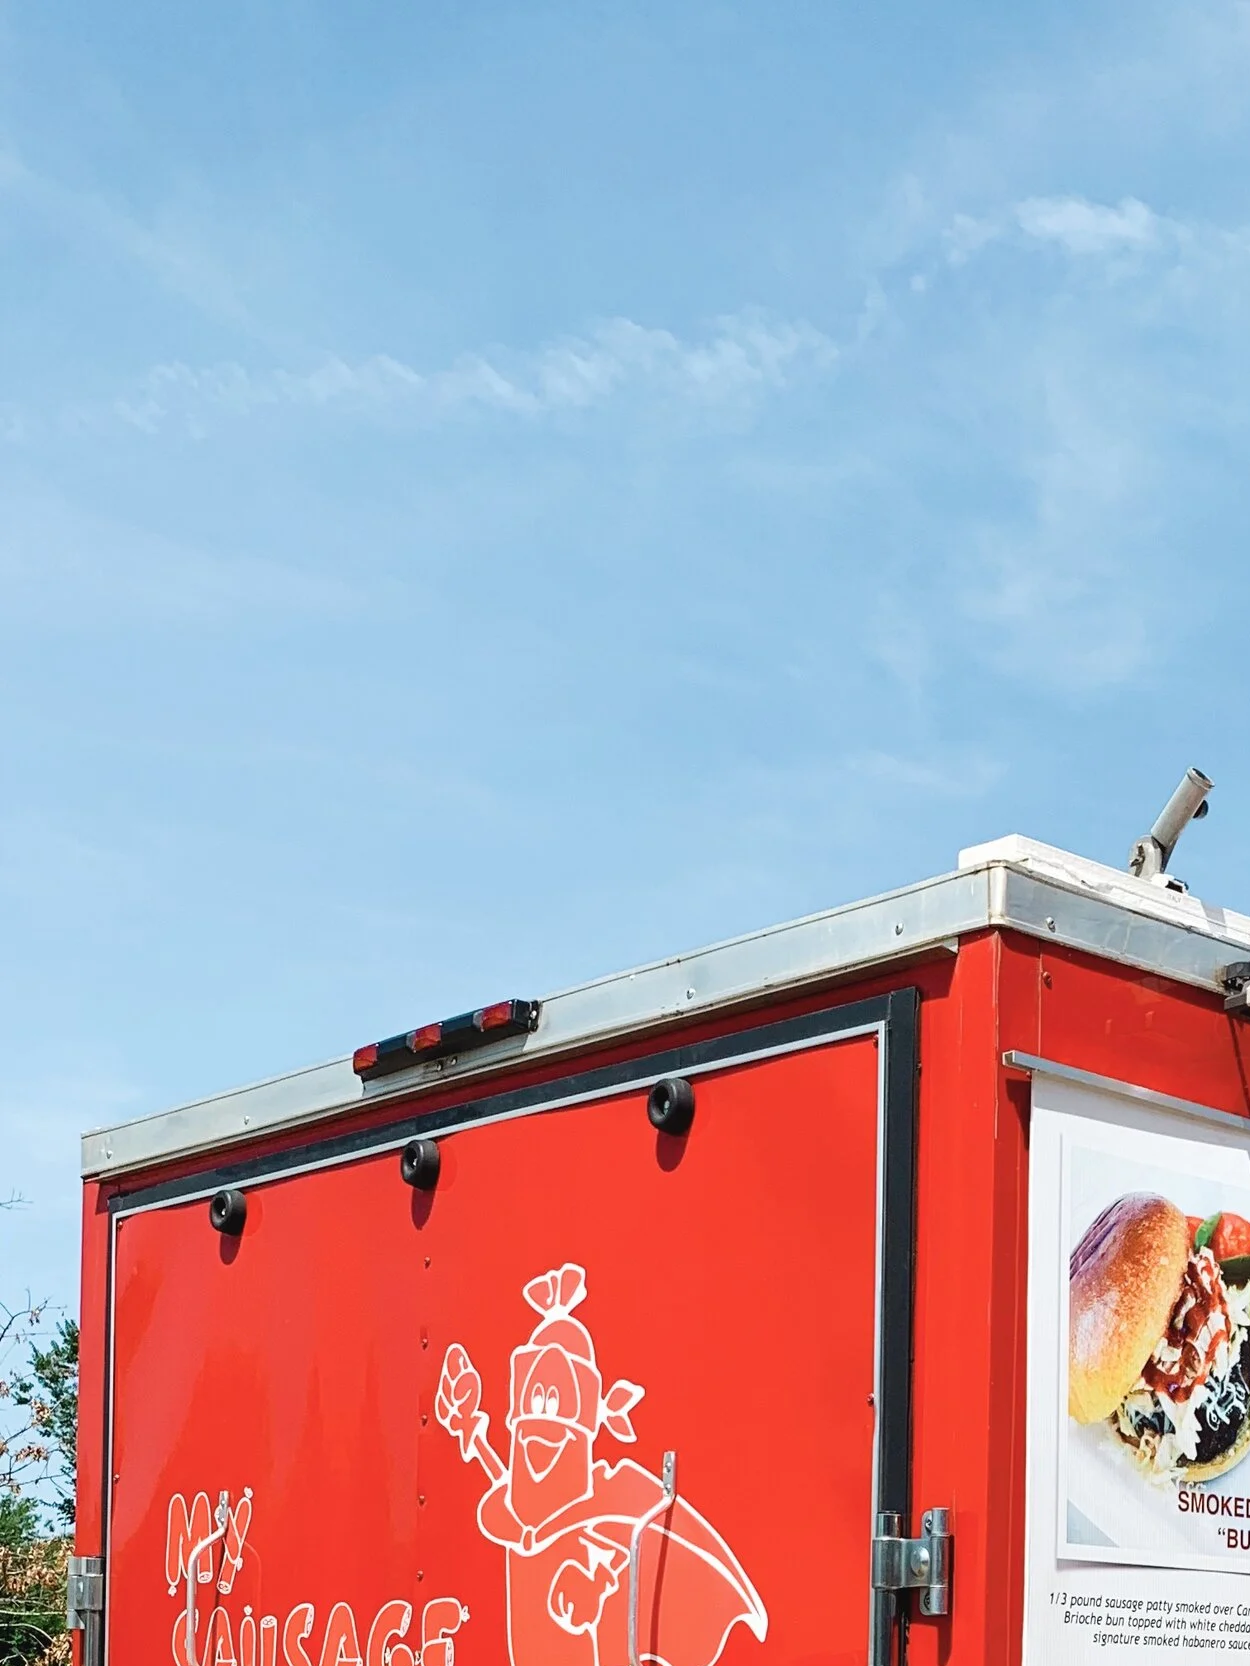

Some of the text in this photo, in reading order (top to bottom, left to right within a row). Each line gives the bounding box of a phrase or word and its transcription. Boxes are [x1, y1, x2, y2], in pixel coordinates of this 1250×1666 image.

[166, 1486, 254, 1596] MY
[1049, 1592, 1067, 1606] 1/3
[1070, 1594, 1102, 1610] pound
[1105, 1597, 1143, 1612] sausage
[1146, 1599, 1172, 1614] patty
[1175, 1600, 1211, 1615] smoked
[1213, 1605, 1234, 1616] over
[1064, 1611, 1103, 1627] Brioche
[1105, 1613, 1125, 1627] bun
[1127, 1615, 1163, 1631] topped
[1165, 1616, 1187, 1631] with
[1189, 1617, 1216, 1632] white
[1093, 1631, 1140, 1647] signature
[1143, 1632, 1180, 1648] smoked
[1182, 1635, 1226, 1650] habanero
